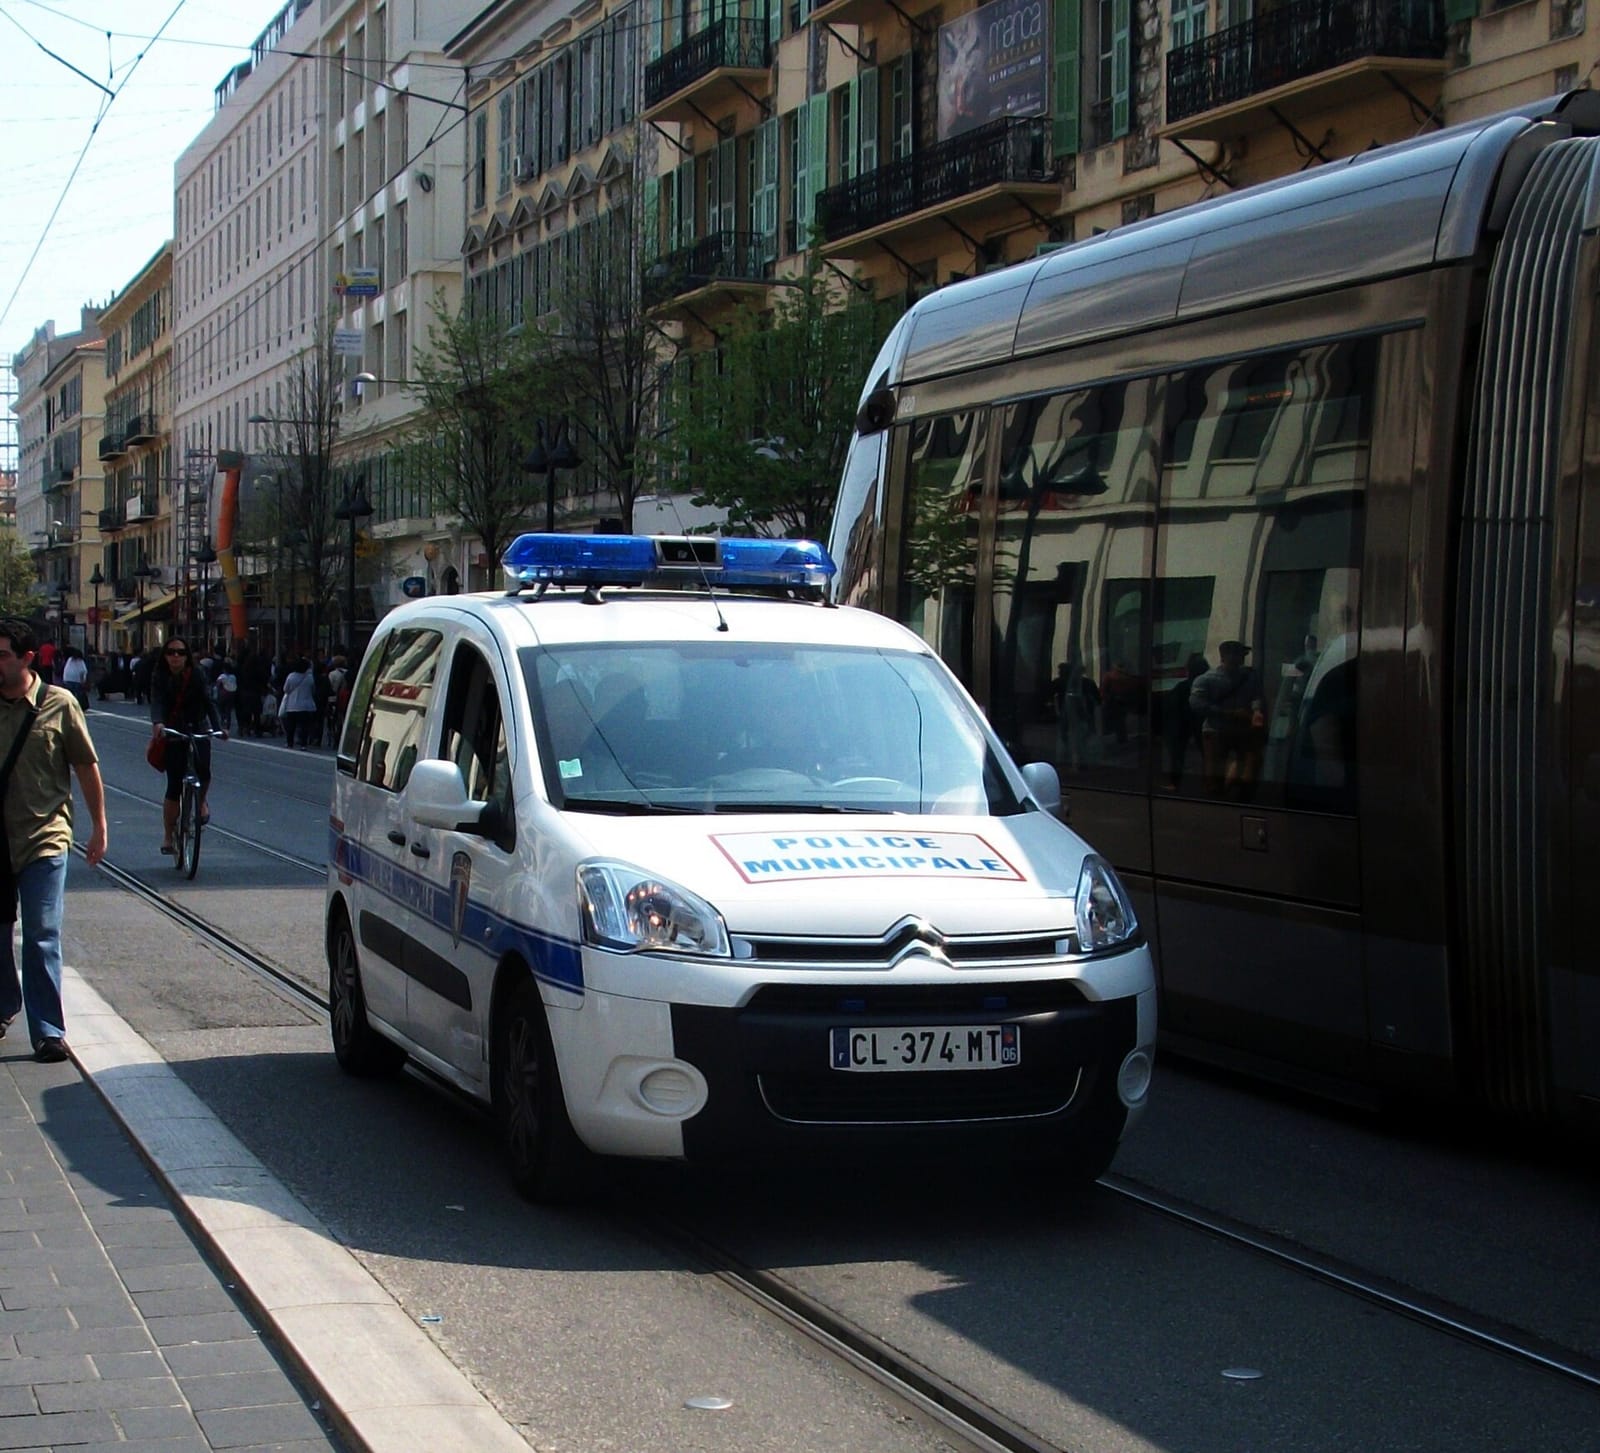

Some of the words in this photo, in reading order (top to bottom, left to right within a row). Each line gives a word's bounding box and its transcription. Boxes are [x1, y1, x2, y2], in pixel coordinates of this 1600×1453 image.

[771, 836, 942, 850] POLICE
[742, 856, 1009, 873] MUNICIPALE
[1002, 1047, 1017, 1061] 06
